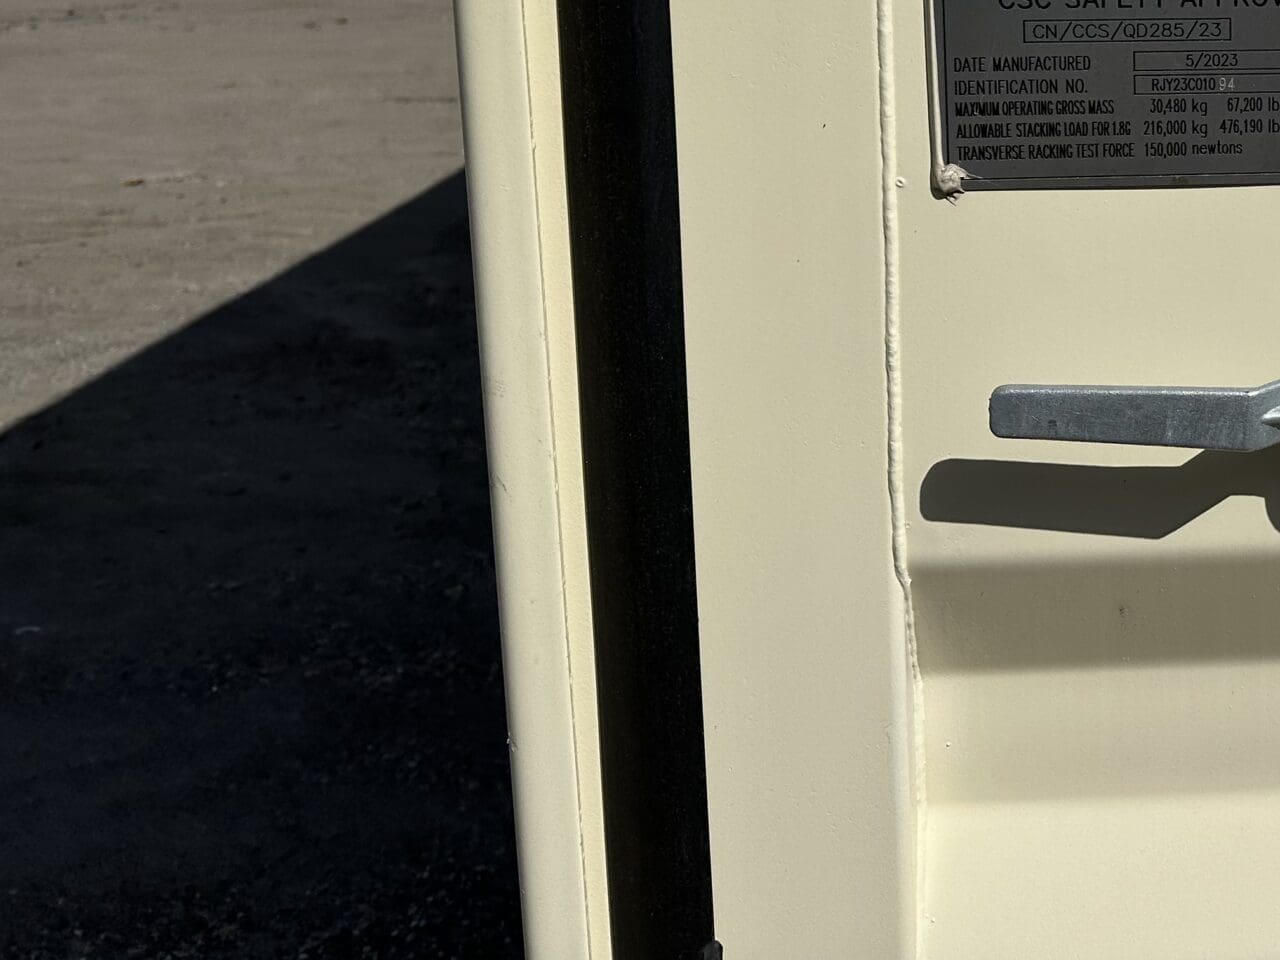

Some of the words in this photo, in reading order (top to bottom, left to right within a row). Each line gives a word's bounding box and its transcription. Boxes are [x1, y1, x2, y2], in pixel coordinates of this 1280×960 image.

[1032, 20, 1222, 41] CN/CCS/QD285/23
[954, 56, 987, 72] DATE
[992, 56, 1091, 72] MANUFACTURED
[1185, 52, 1239, 69] 5/2023
[954, 79, 1058, 96] IDENTIFICATION
[1065, 78, 1089, 94] NO.
[954, 102, 1000, 117] MAXIMUM
[1002, 100, 1054, 116] OPERATING
[1055, 100, 1086, 115] GROSS
[1088, 100, 1115, 115] MASS
[1150, 98, 1187, 116] 30,480
[1192, 98, 1208, 116] kg
[1226, 97, 1263, 114] 67,200
[956, 122, 1012, 139] ALLOWABLE
[1016, 122, 1062, 138] STACKING
[1064, 122, 1089, 137] LOAD
[1092, 122, 1110, 136] FOR
[1112, 121, 1132, 136] 1.8G
[1144, 120, 1188, 137] 216,000
[1192, 120, 1208, 138] kg
[1219, 118, 1263, 136] 476,190
[957, 144, 1026, 161] TRANSVERSE
[1028, 144, 1073, 160] RACKING
[1075, 143, 1100, 158] TEST
[1102, 142, 1136, 158] FORCE
[1144, 142, 1187, 158] 150,000
[1192, 140, 1244, 155] newtons
